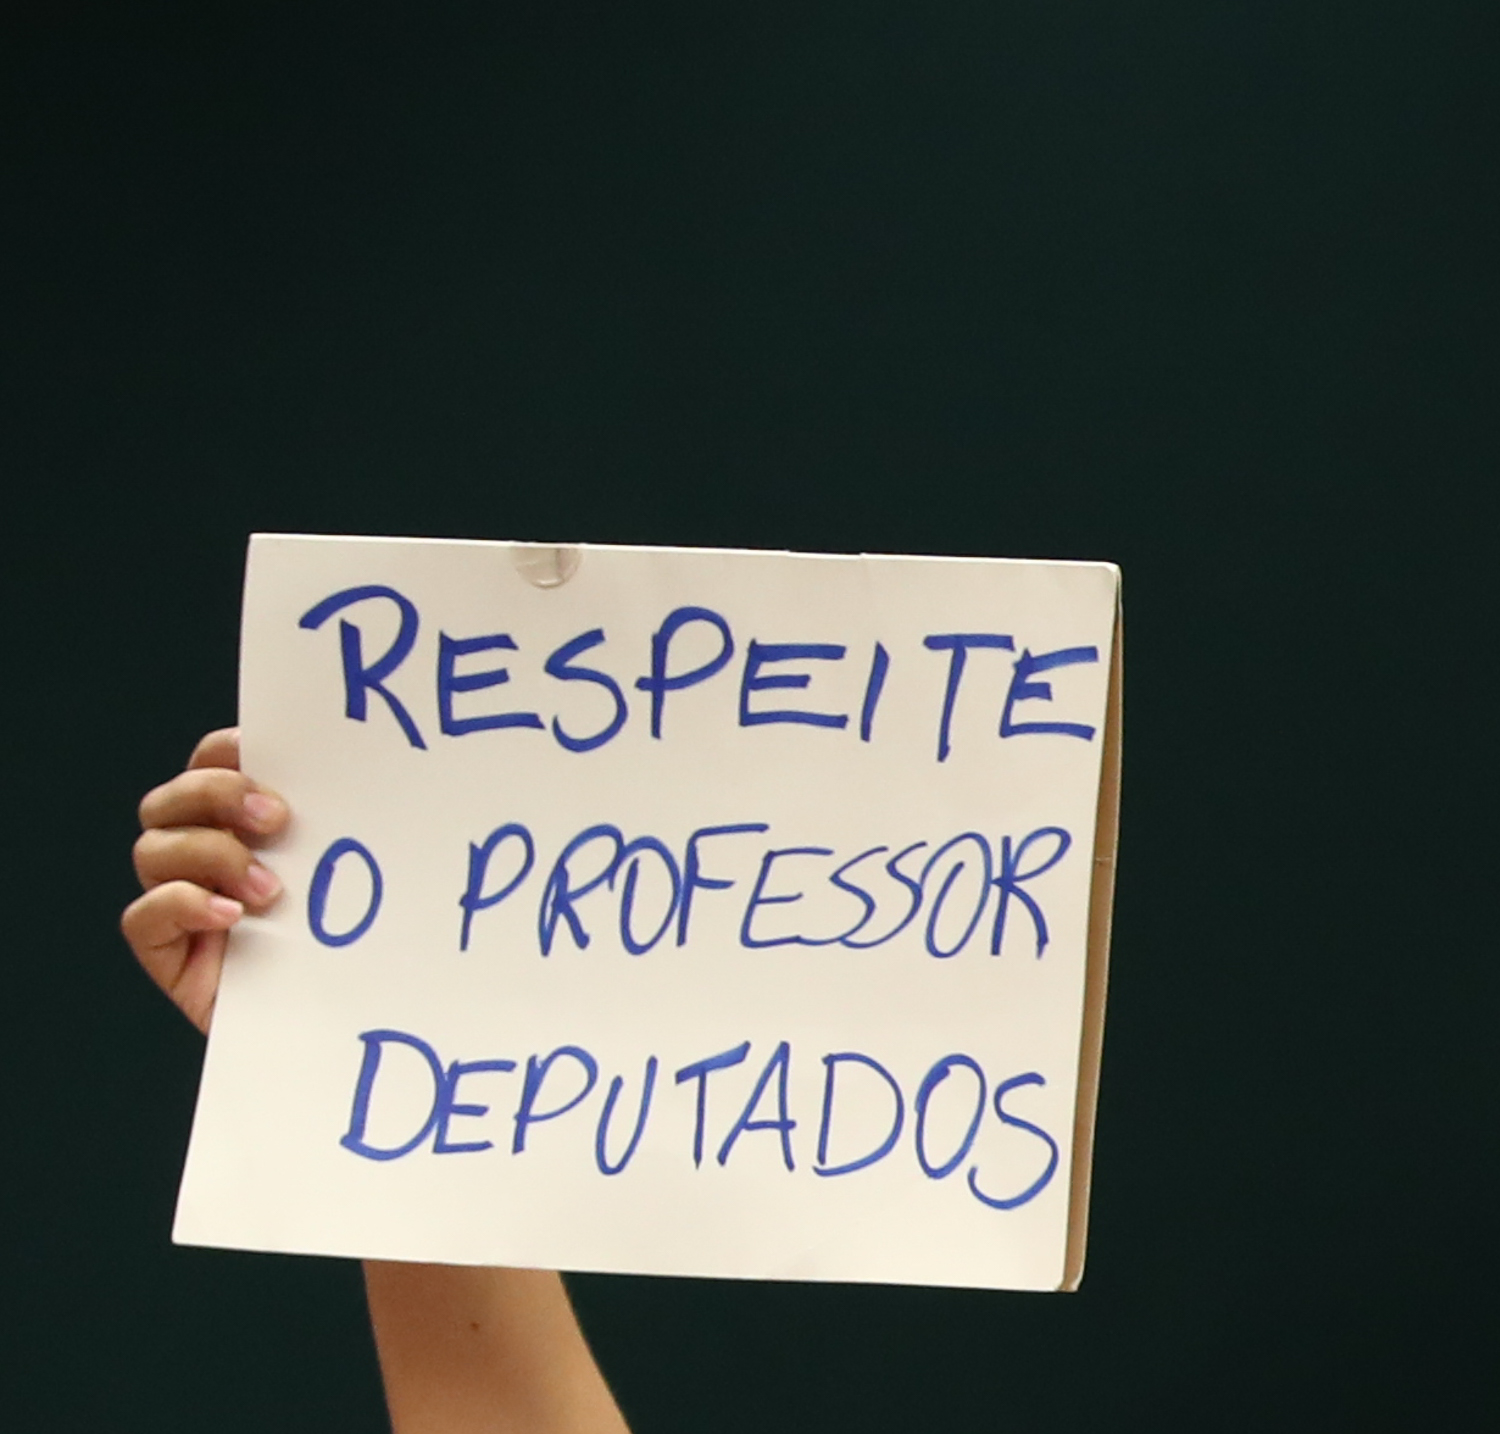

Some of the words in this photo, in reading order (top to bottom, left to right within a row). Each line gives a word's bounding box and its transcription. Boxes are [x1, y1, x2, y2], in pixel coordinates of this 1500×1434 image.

[300, 586, 1097, 760] RESPEITE
[310, 838, 383, 947] O
[461, 823, 1071, 958] PROFESSOR
[341, 1030, 1058, 1210] DEPUTADOS
